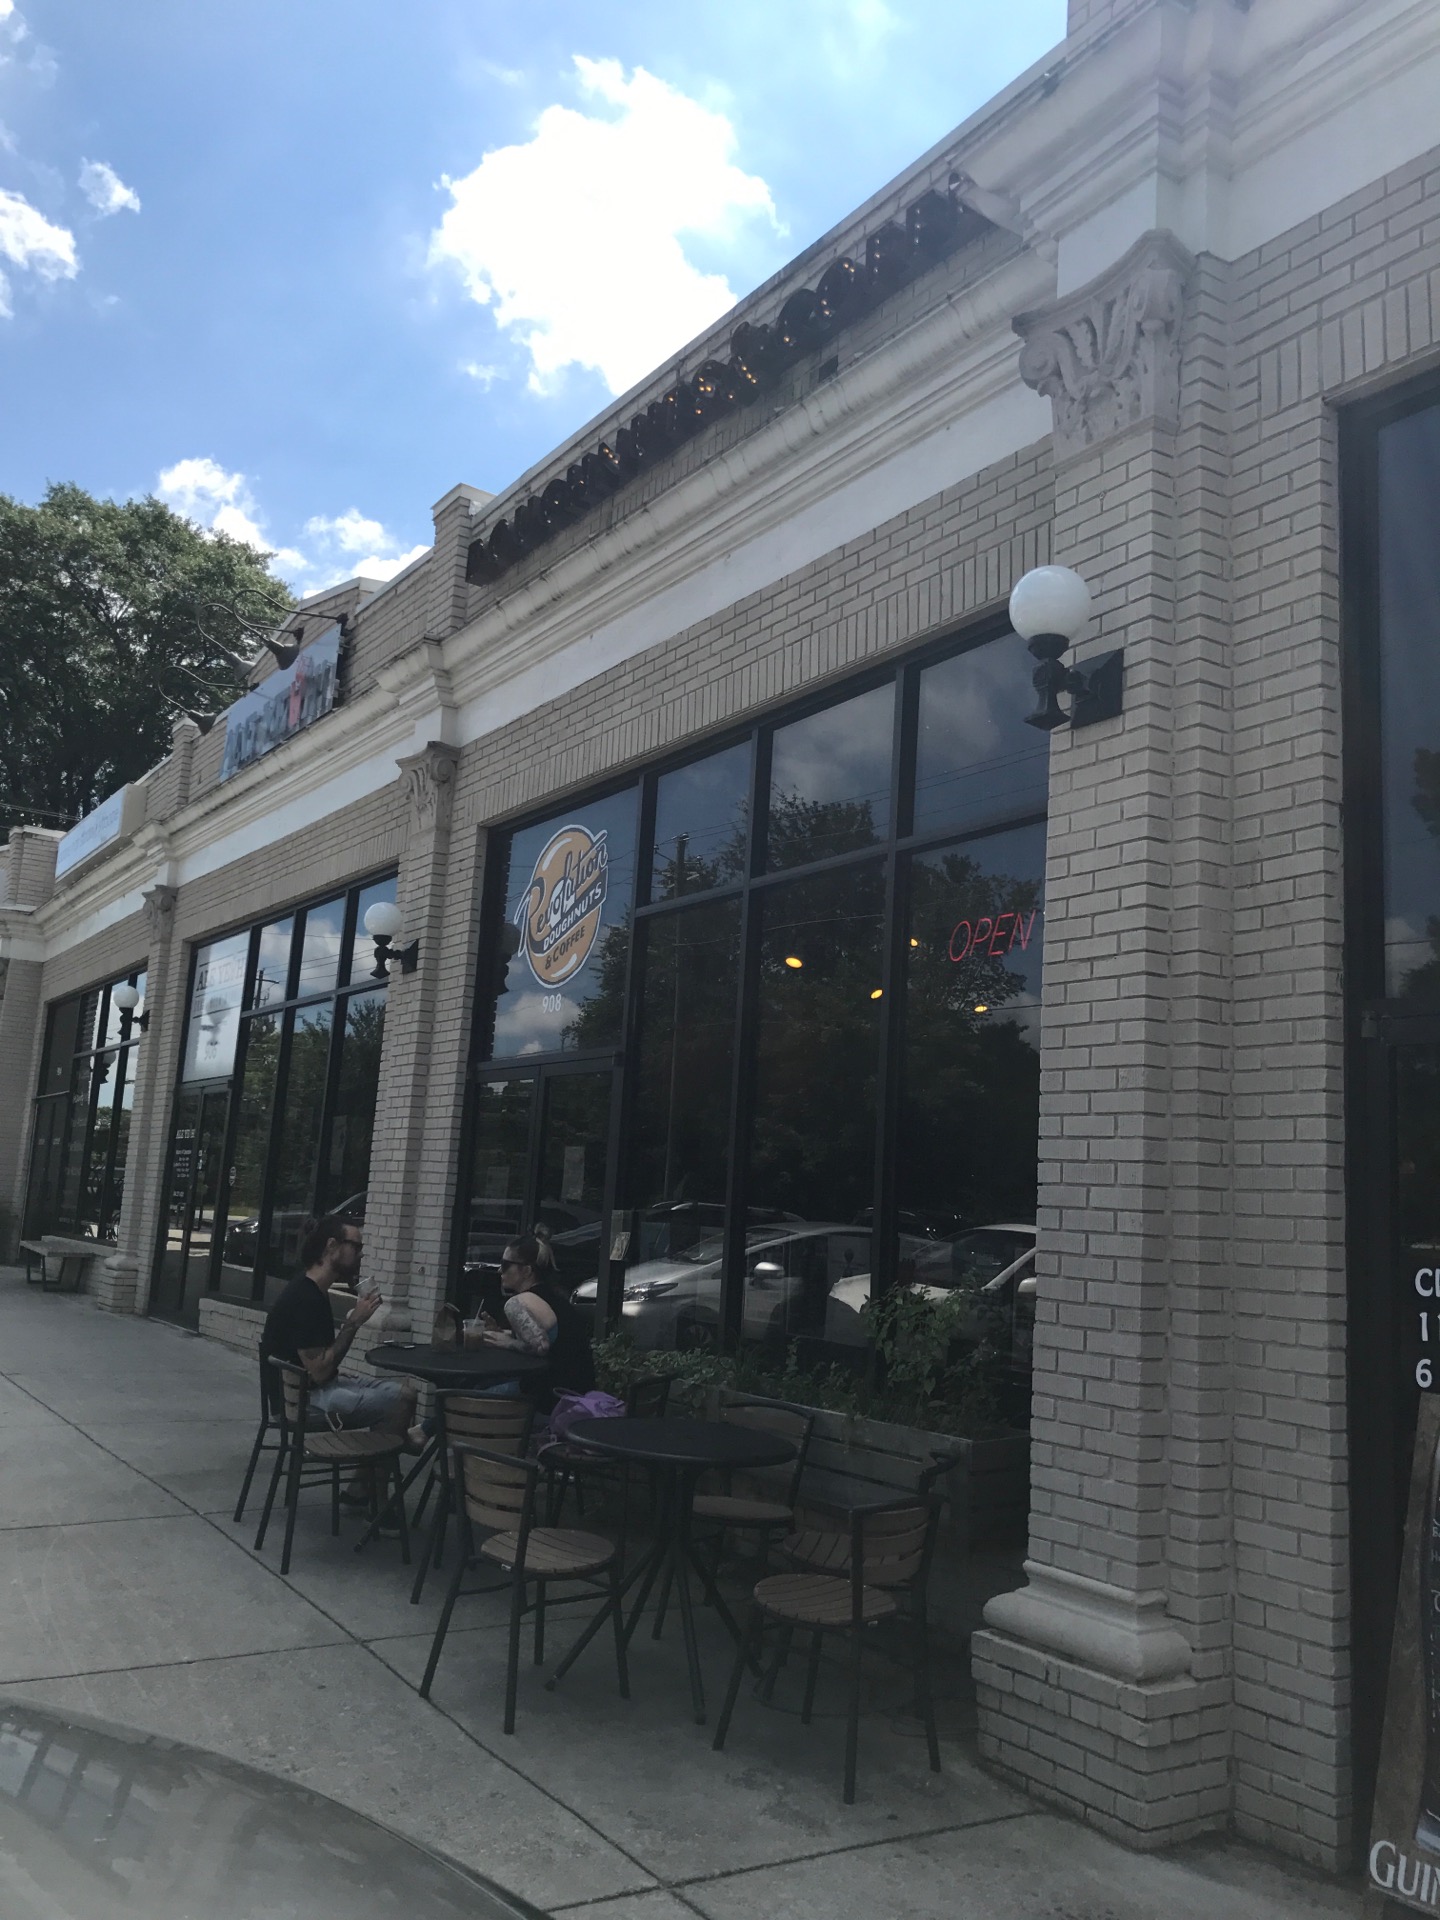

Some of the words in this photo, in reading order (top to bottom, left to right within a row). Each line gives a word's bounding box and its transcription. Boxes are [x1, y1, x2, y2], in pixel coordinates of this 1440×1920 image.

[543, 881, 603, 951] DOUGHNUTS
[948, 909, 1037, 962] OPEN
[552, 925, 586, 964] COFFEE
[541, 992, 563, 1015] 908
